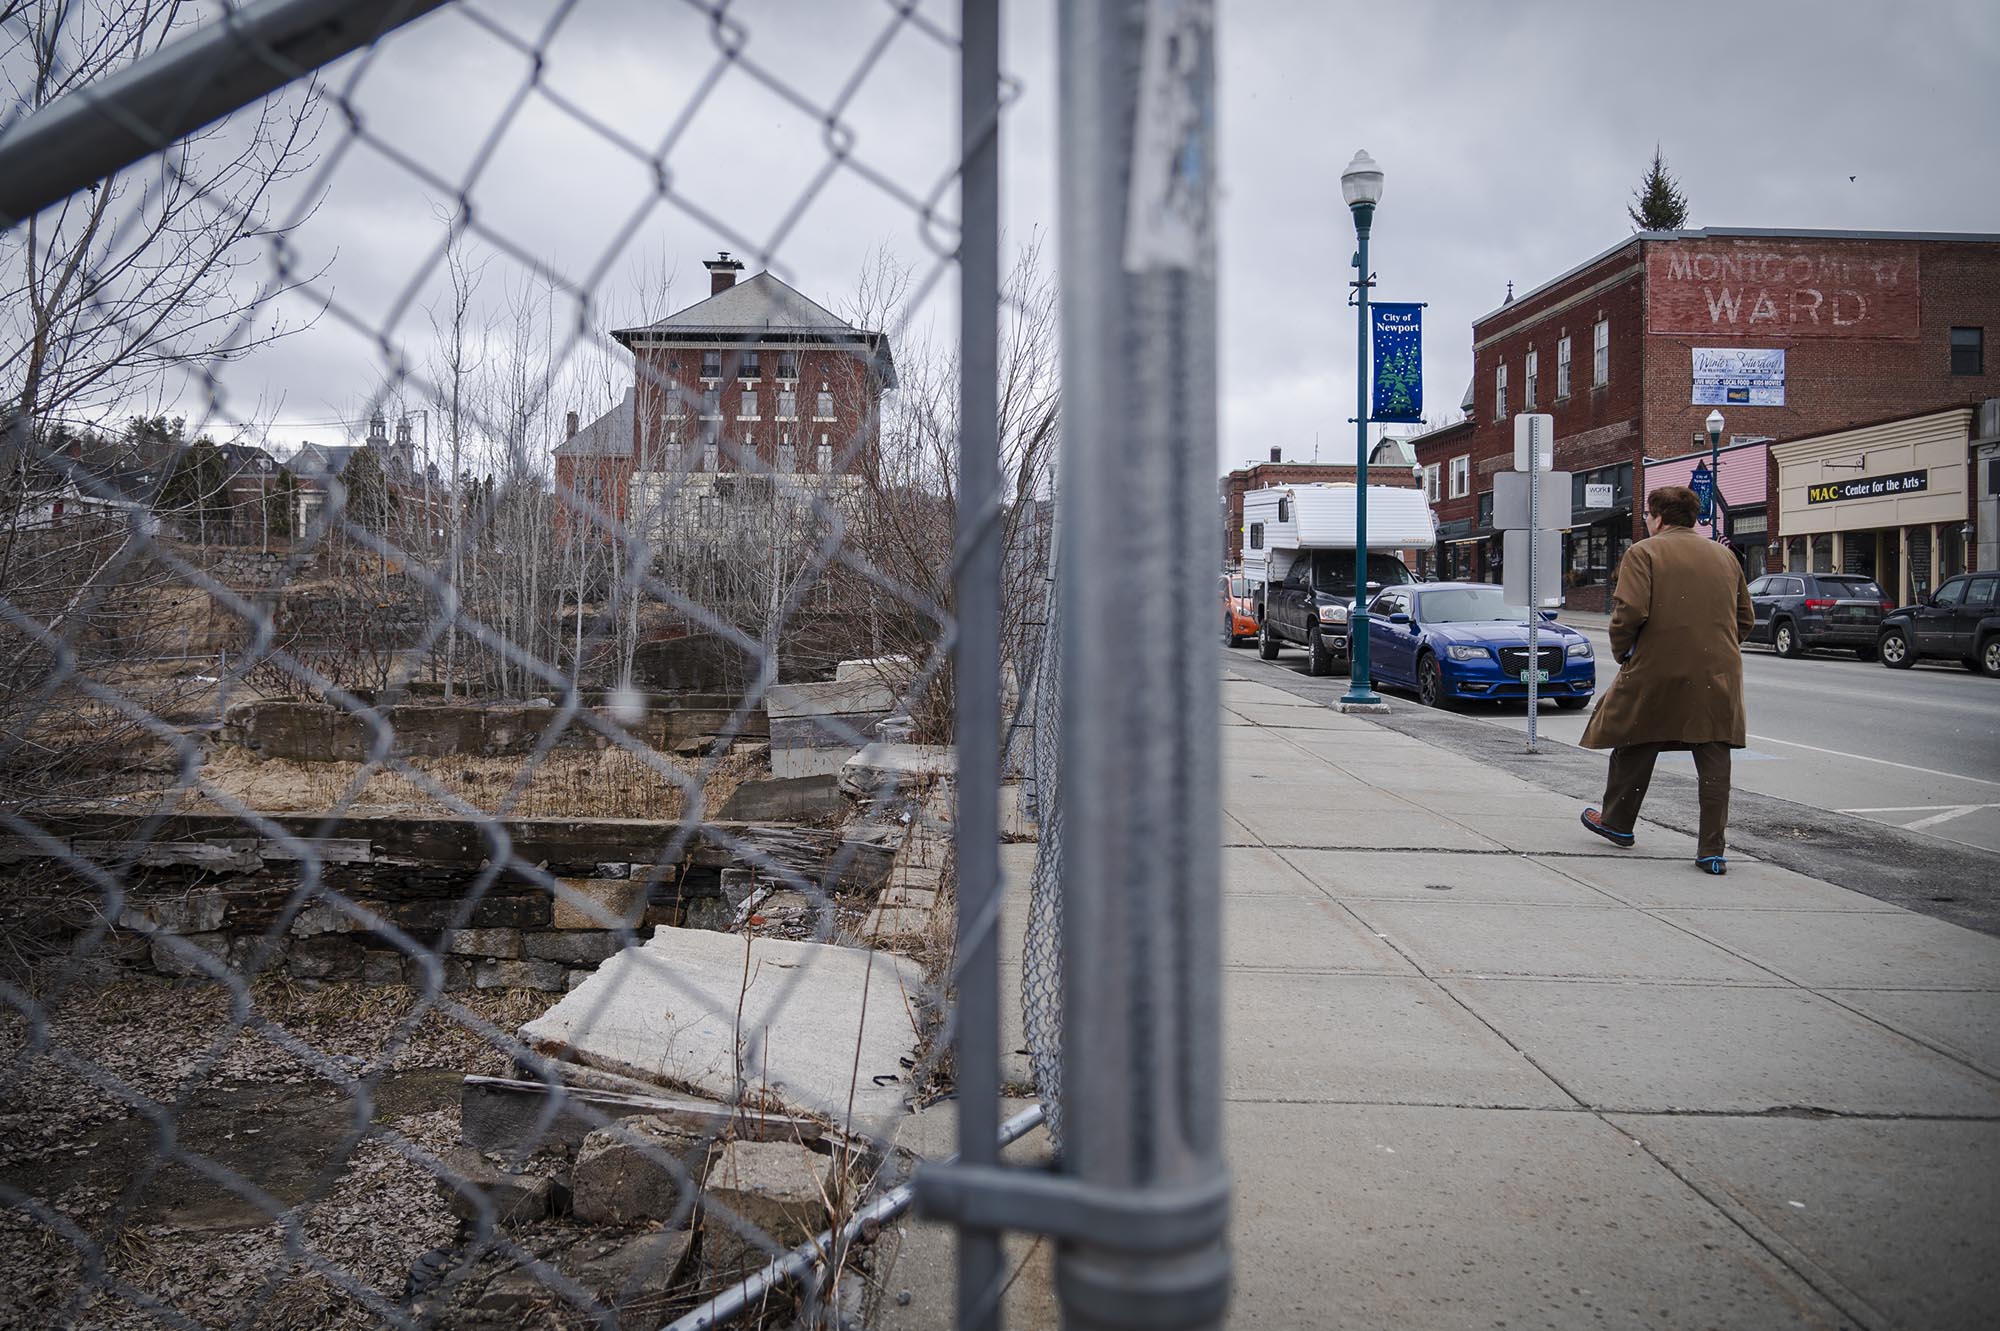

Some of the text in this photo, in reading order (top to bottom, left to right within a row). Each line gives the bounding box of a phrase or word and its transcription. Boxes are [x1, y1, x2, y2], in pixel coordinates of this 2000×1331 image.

[1703, 287, 1868, 325] WARD
[1376, 322, 1419, 334] Newport
[1382, 313, 1412, 323] City of
[1694, 350, 1731, 370] Winter
[1810, 486, 1839, 501] MAC
[1845, 484, 1870, 496] Center
[1872, 481, 1884, 493] for
[1886, 480, 1900, 491] the
[1902, 476, 1919, 489] Arts
